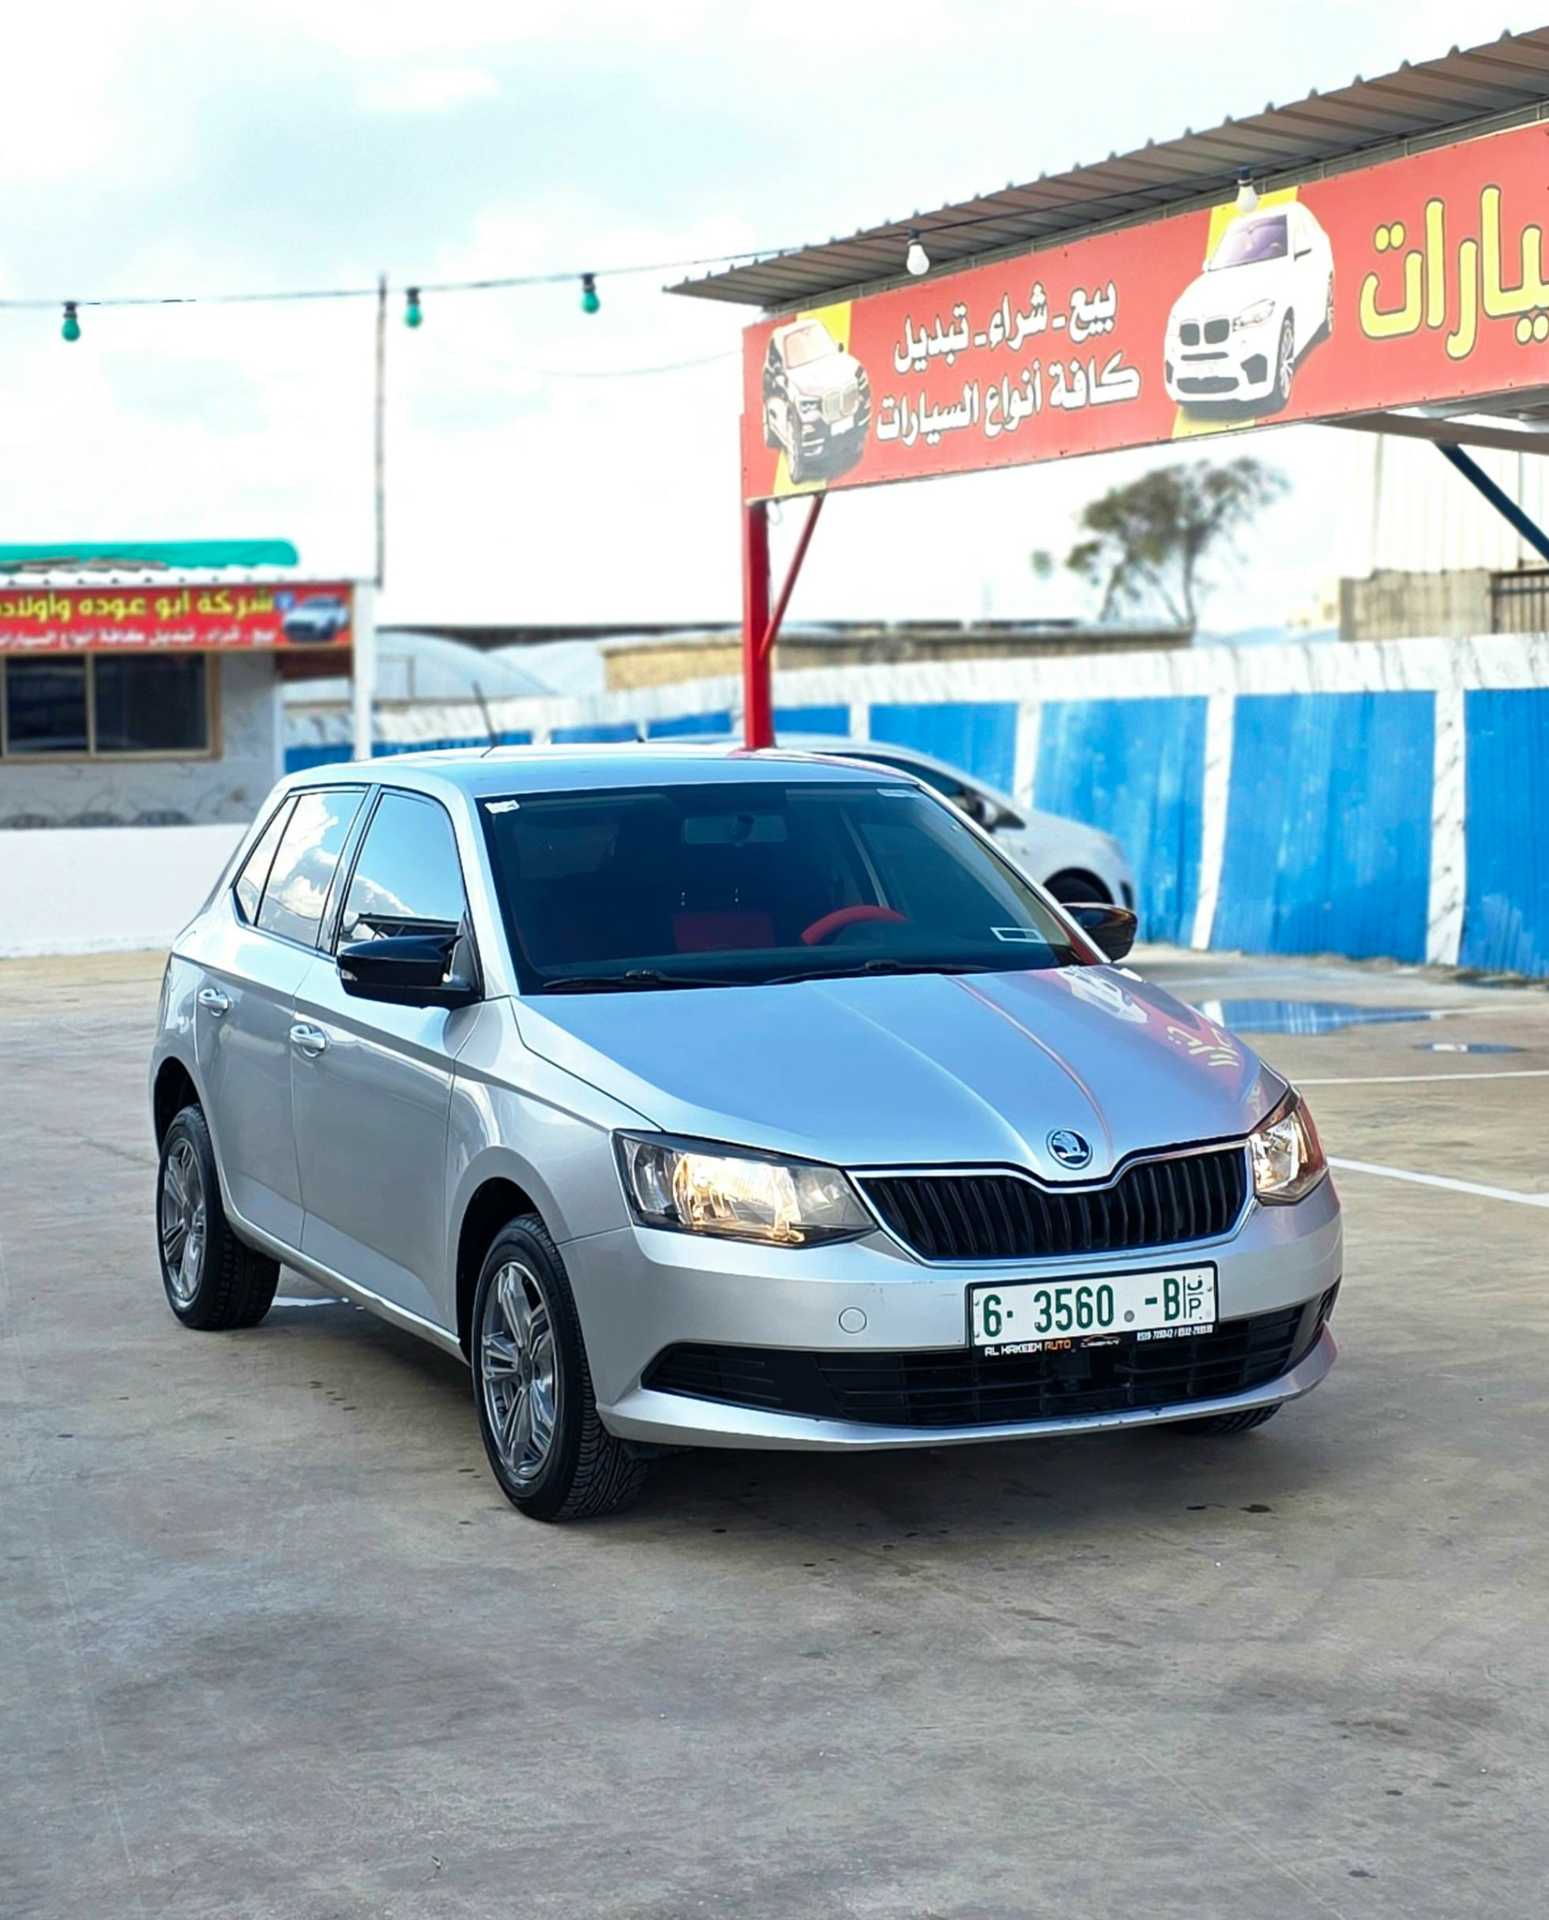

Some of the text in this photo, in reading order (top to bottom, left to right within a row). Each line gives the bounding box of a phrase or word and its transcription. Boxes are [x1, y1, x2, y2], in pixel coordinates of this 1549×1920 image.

[1360, 184, 1549, 360] يارات
[894, 303, 969, 374] تبديل
[988, 281, 1048, 352] شراء
[1069, 280, 1117, 344] بيع
[876, 350, 1142, 447] كافة أنواع السيارات
[197, 589, 273, 621] شركة
[1033, 1284, 1115, 1333] 3560
